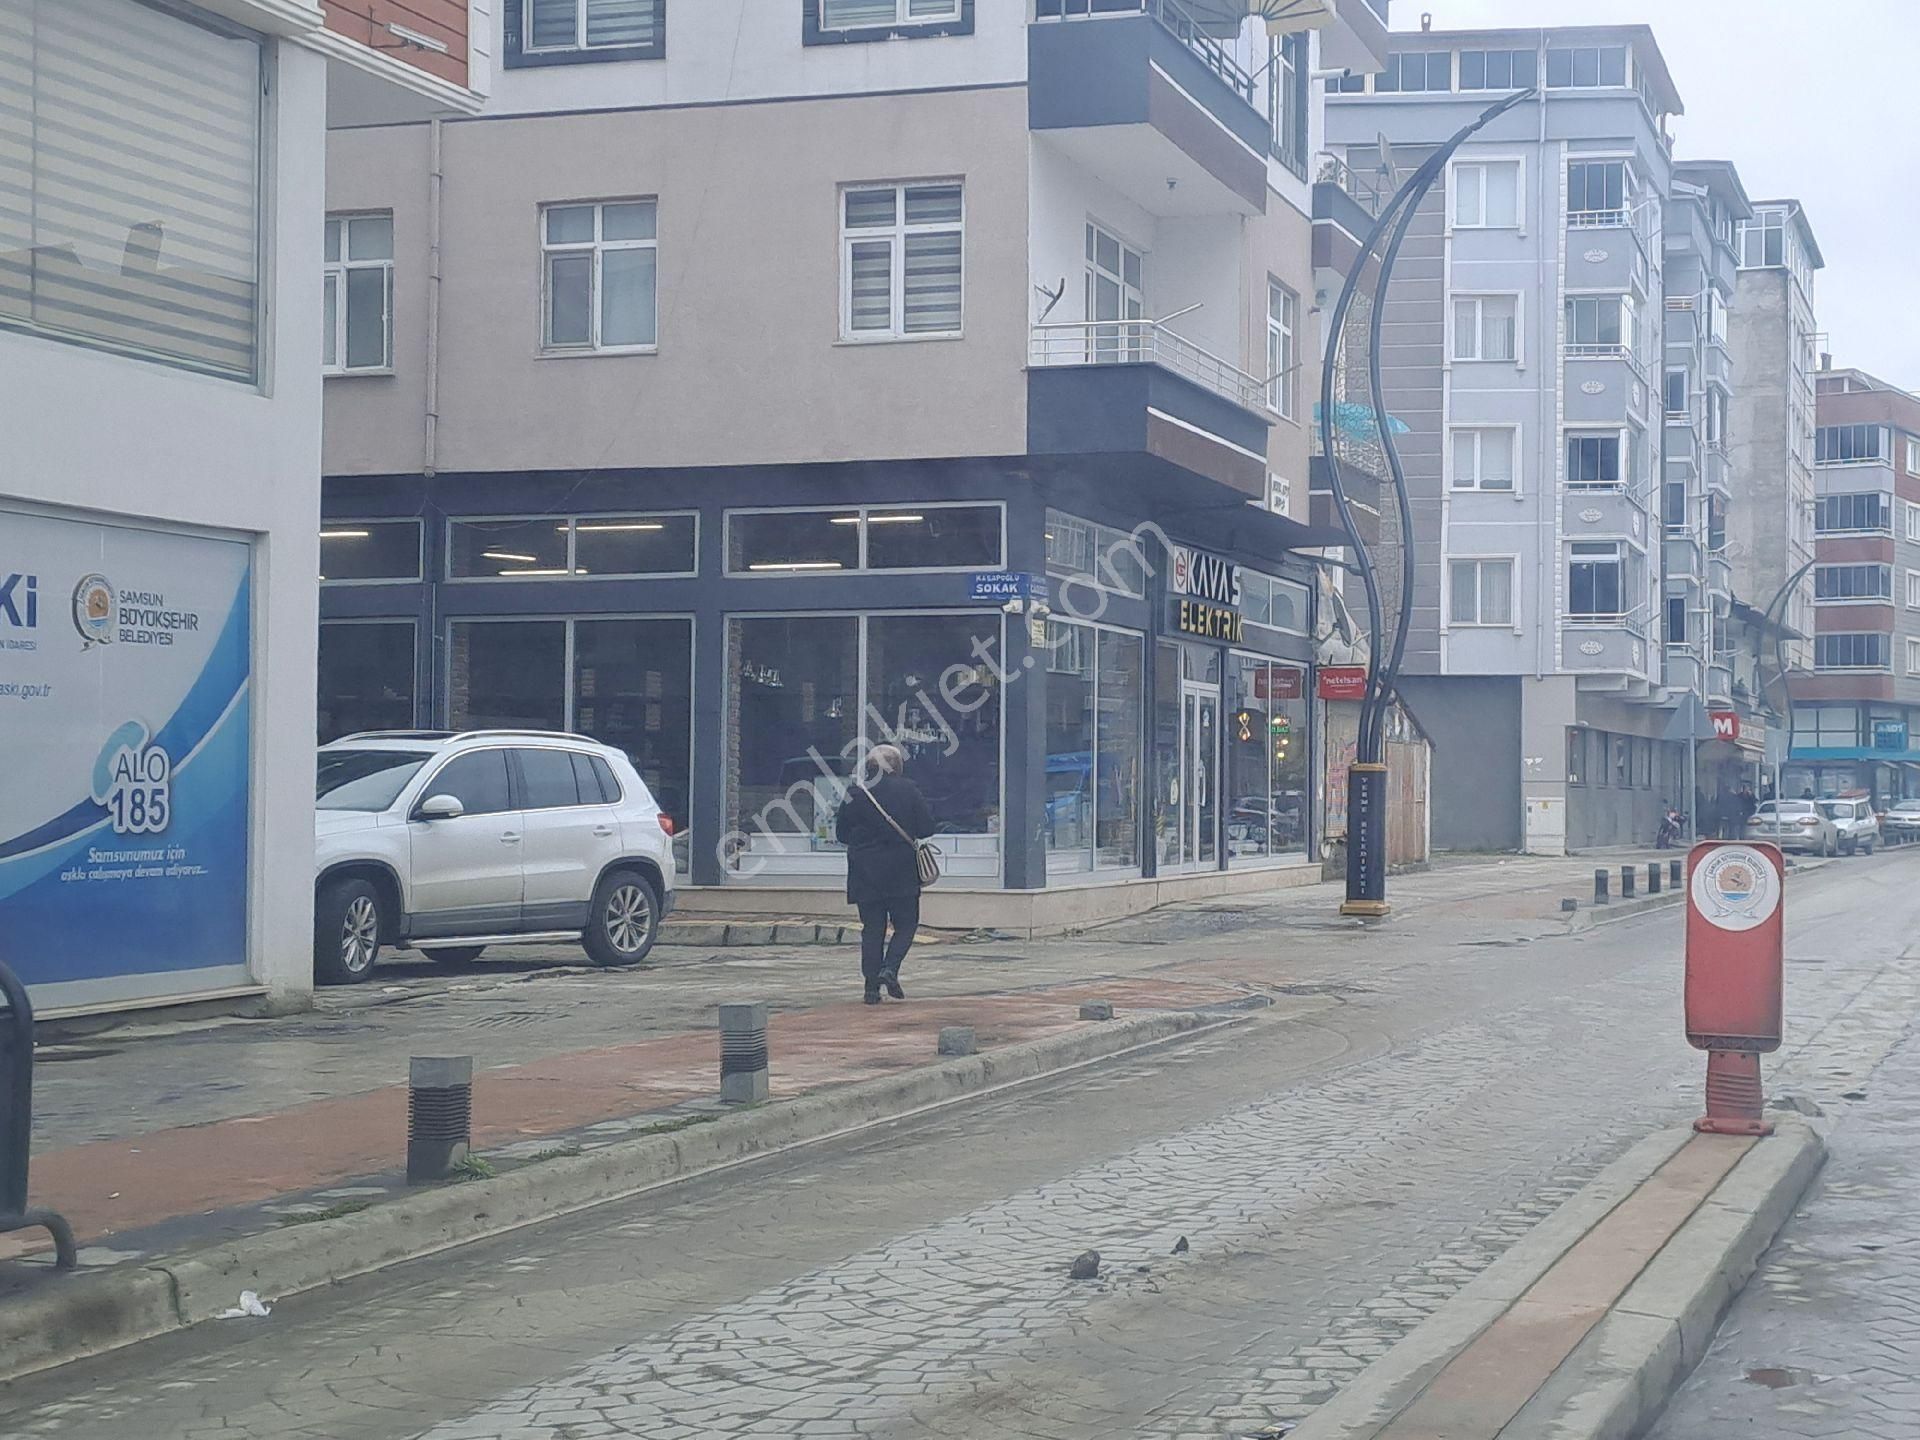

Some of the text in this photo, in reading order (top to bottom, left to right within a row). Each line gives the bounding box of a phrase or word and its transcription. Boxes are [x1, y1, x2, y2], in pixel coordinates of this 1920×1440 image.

[119, 589, 163, 607] SAMSUN
[976, 583, 1018, 594] SOKAK
[119, 607, 199, 631] BÜYÜKŞEHİR
[1713, 718, 1733, 736] M
[114, 753, 165, 783] ALO
[112, 788, 166, 827] 185
[88, 844, 186, 864] Samsunumuz için
